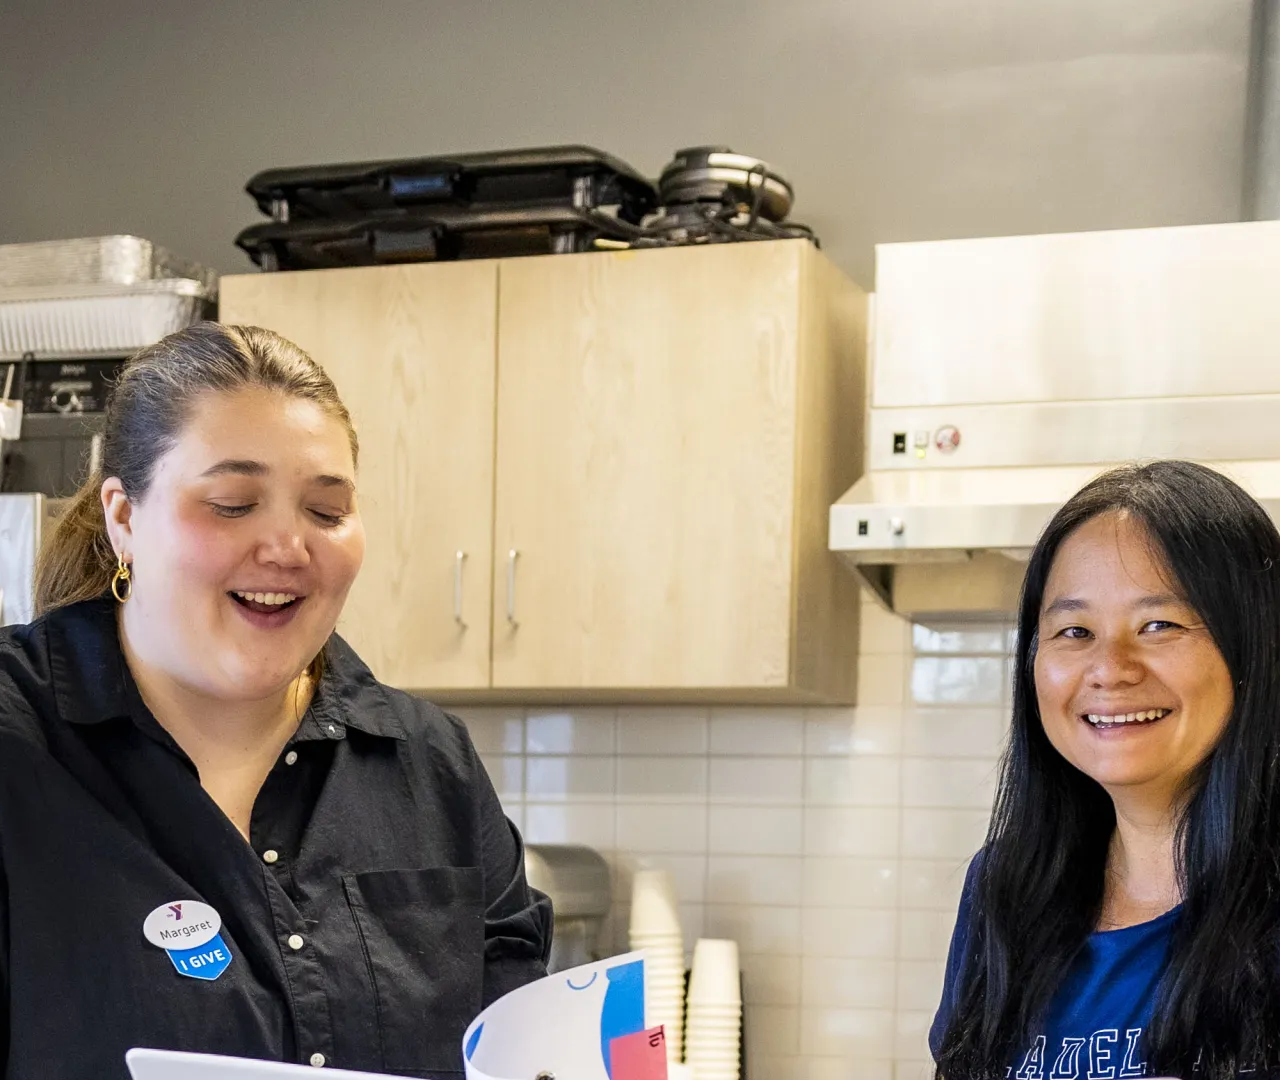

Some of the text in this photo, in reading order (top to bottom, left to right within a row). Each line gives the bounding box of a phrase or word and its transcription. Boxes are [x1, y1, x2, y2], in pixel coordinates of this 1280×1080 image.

[160, 920, 212, 940] Margaret
[180, 948, 226, 971] I GIVE
